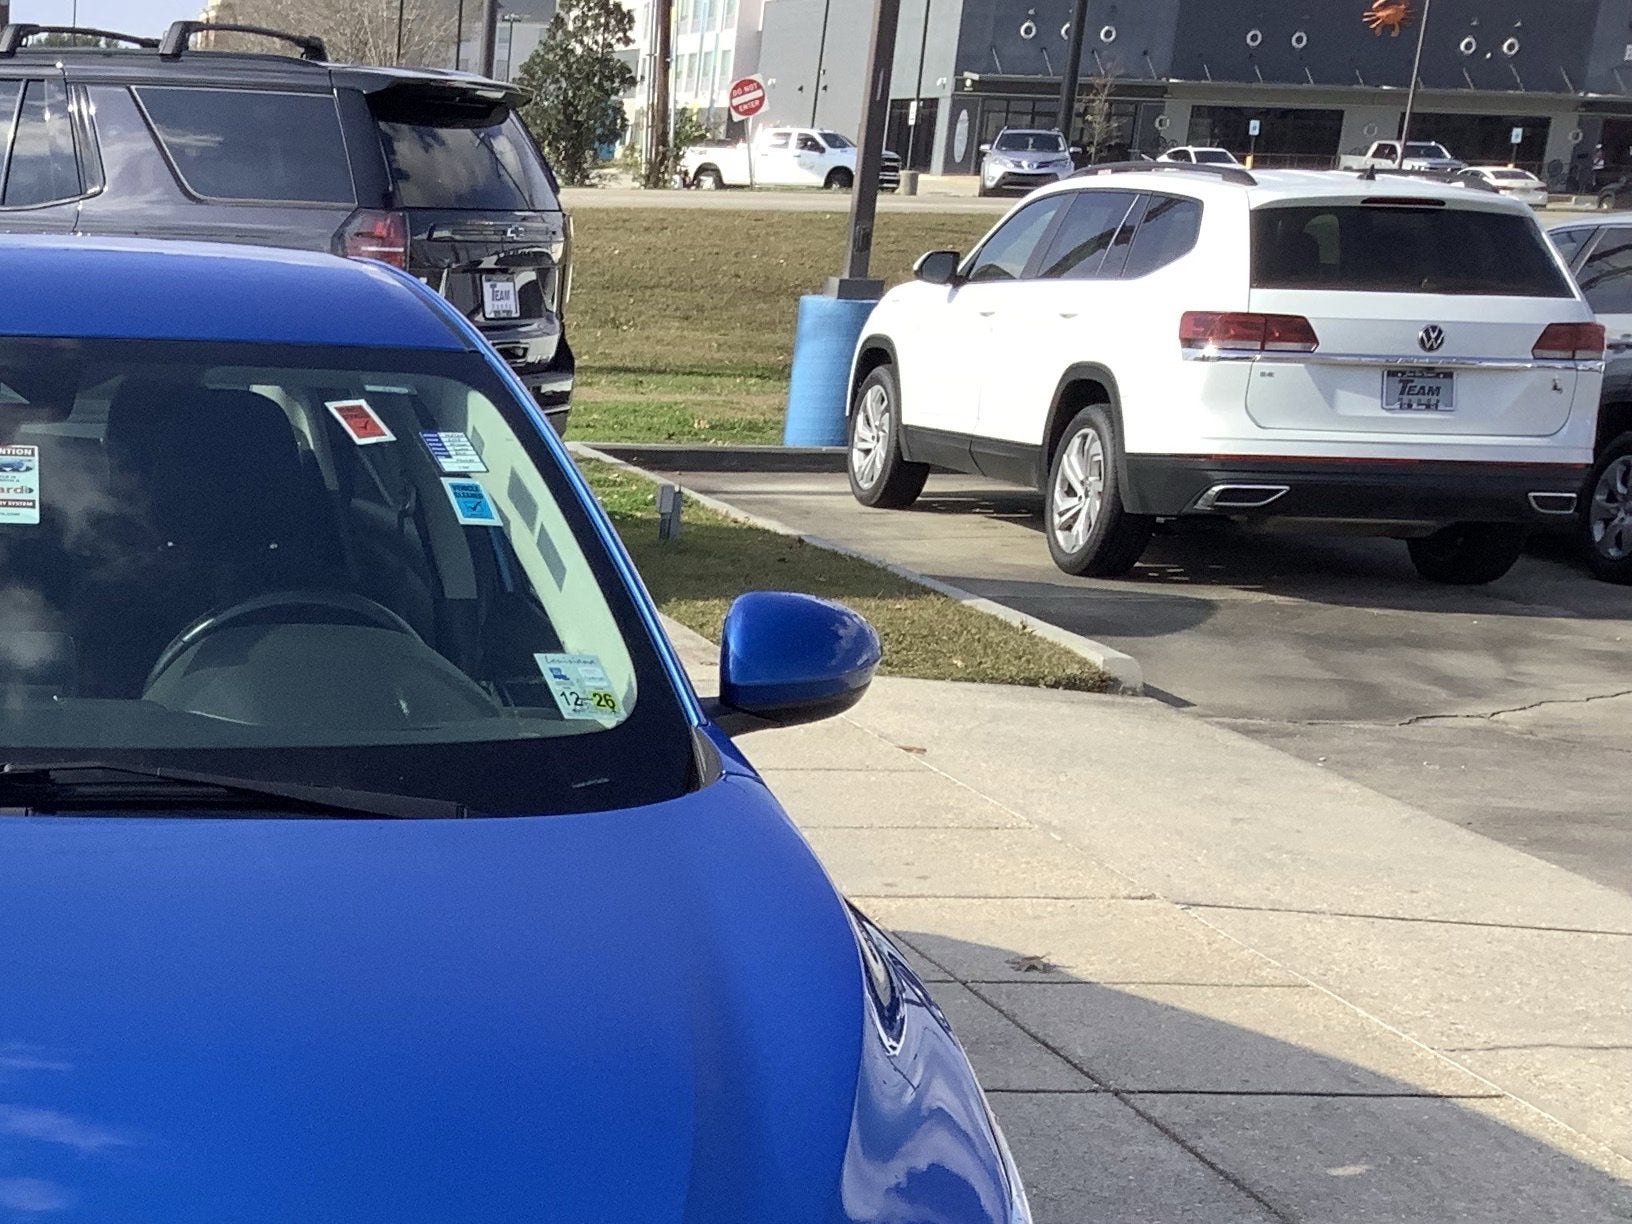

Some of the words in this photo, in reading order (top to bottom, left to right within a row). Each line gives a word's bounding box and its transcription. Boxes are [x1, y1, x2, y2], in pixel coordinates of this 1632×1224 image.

[733, 87, 743, 97] DO
[744, 82, 758, 92] NOT
[738, 99, 760, 112] ENTER
[1398, 378, 1442, 397] TEAM
[592, 692, 616, 709] 26
